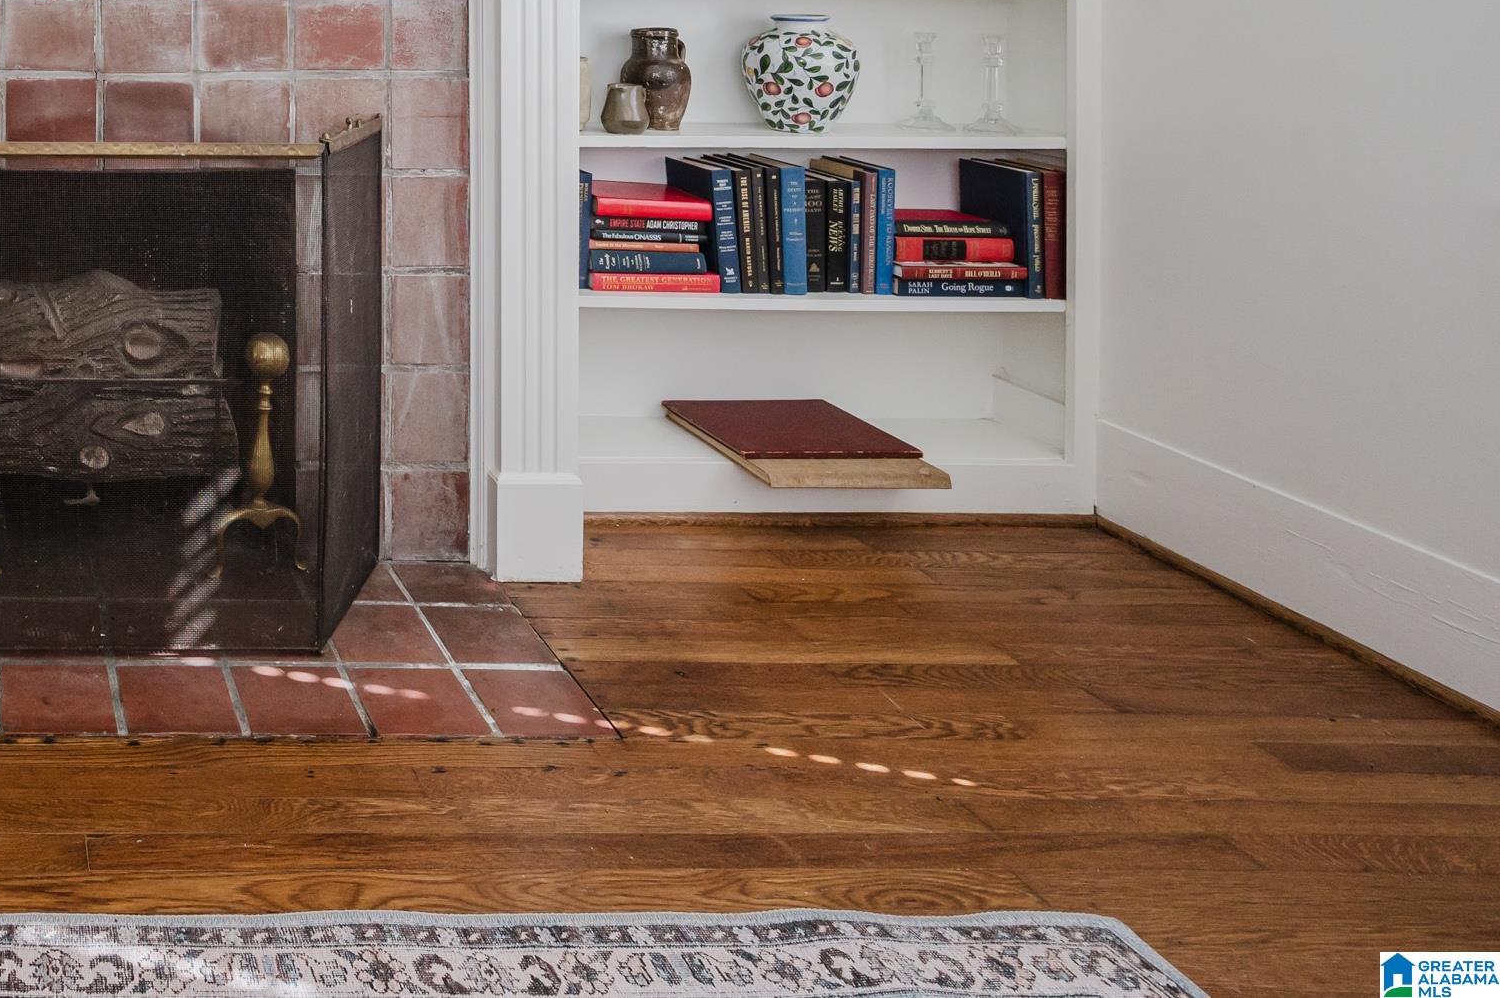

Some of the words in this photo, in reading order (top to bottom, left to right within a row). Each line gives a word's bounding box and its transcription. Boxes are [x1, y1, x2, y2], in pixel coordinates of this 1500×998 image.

[740, 176, 748, 187] THE
[610, 219, 629, 228] EMPIRE
[630, 219, 646, 229] STATE
[646, 220, 662, 229] ADAM
[662, 221, 698, 230] CHRISTOPHER
[742, 209, 750, 233] AMERICA
[612, 232, 634, 240] Fabulous
[634, 233, 662, 241] ONASSIS
[829, 220, 838, 252] NEWS
[620, 275, 660, 283] GREATEST
[941, 283, 966, 293] Going
[968, 283, 994, 293] Rogue
